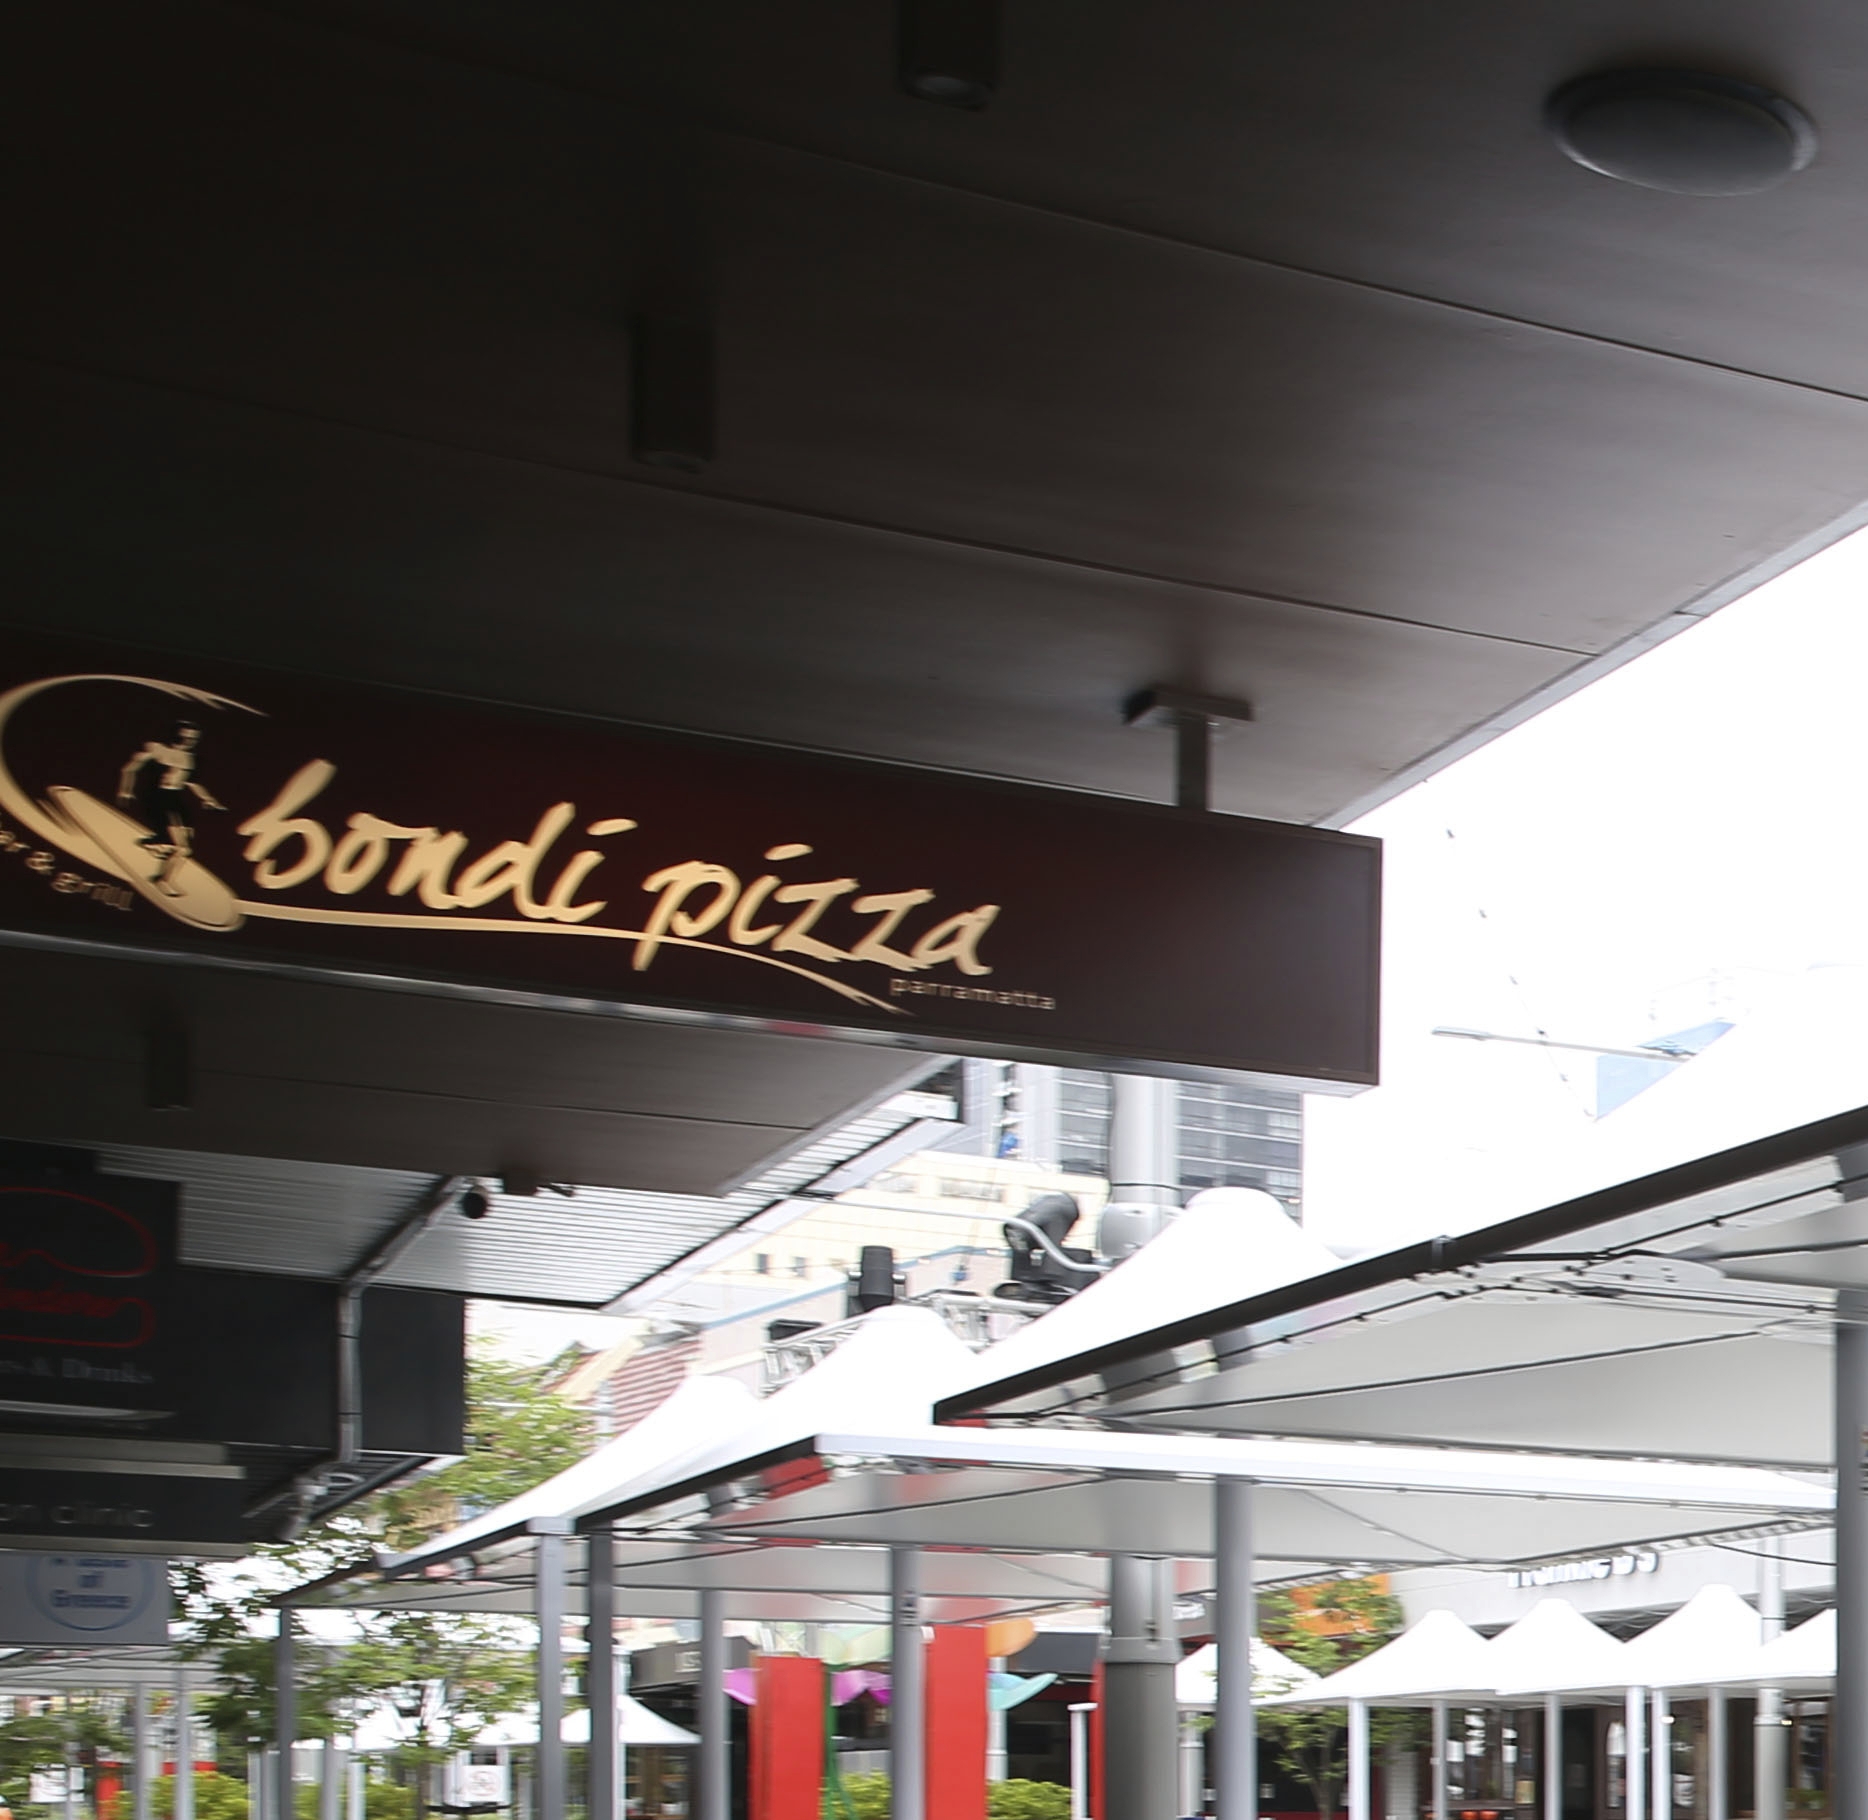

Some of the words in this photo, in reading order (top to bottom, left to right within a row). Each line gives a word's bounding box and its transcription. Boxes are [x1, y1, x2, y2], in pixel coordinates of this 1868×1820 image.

[237, 759, 638, 923] bondi
[632, 843, 1001, 976] pizza
[889, 976, 1056, 1011] parramatta
